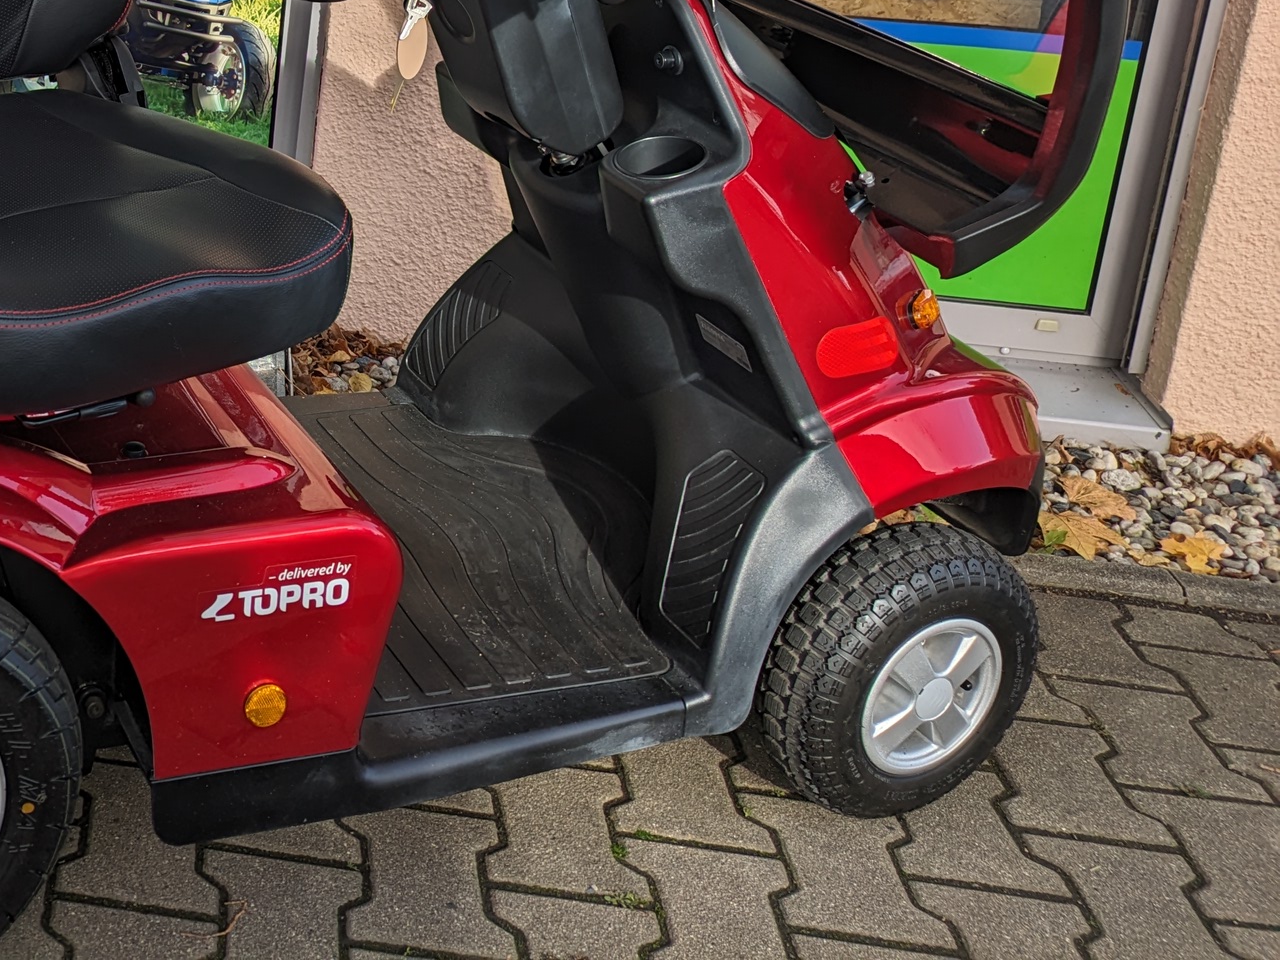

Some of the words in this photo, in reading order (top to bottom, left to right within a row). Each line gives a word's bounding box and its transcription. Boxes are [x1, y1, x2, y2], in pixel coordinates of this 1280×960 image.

[278, 562, 335, 581] delivered
[336, 561, 352, 575] by
[238, 578, 350, 618] TOPRO
